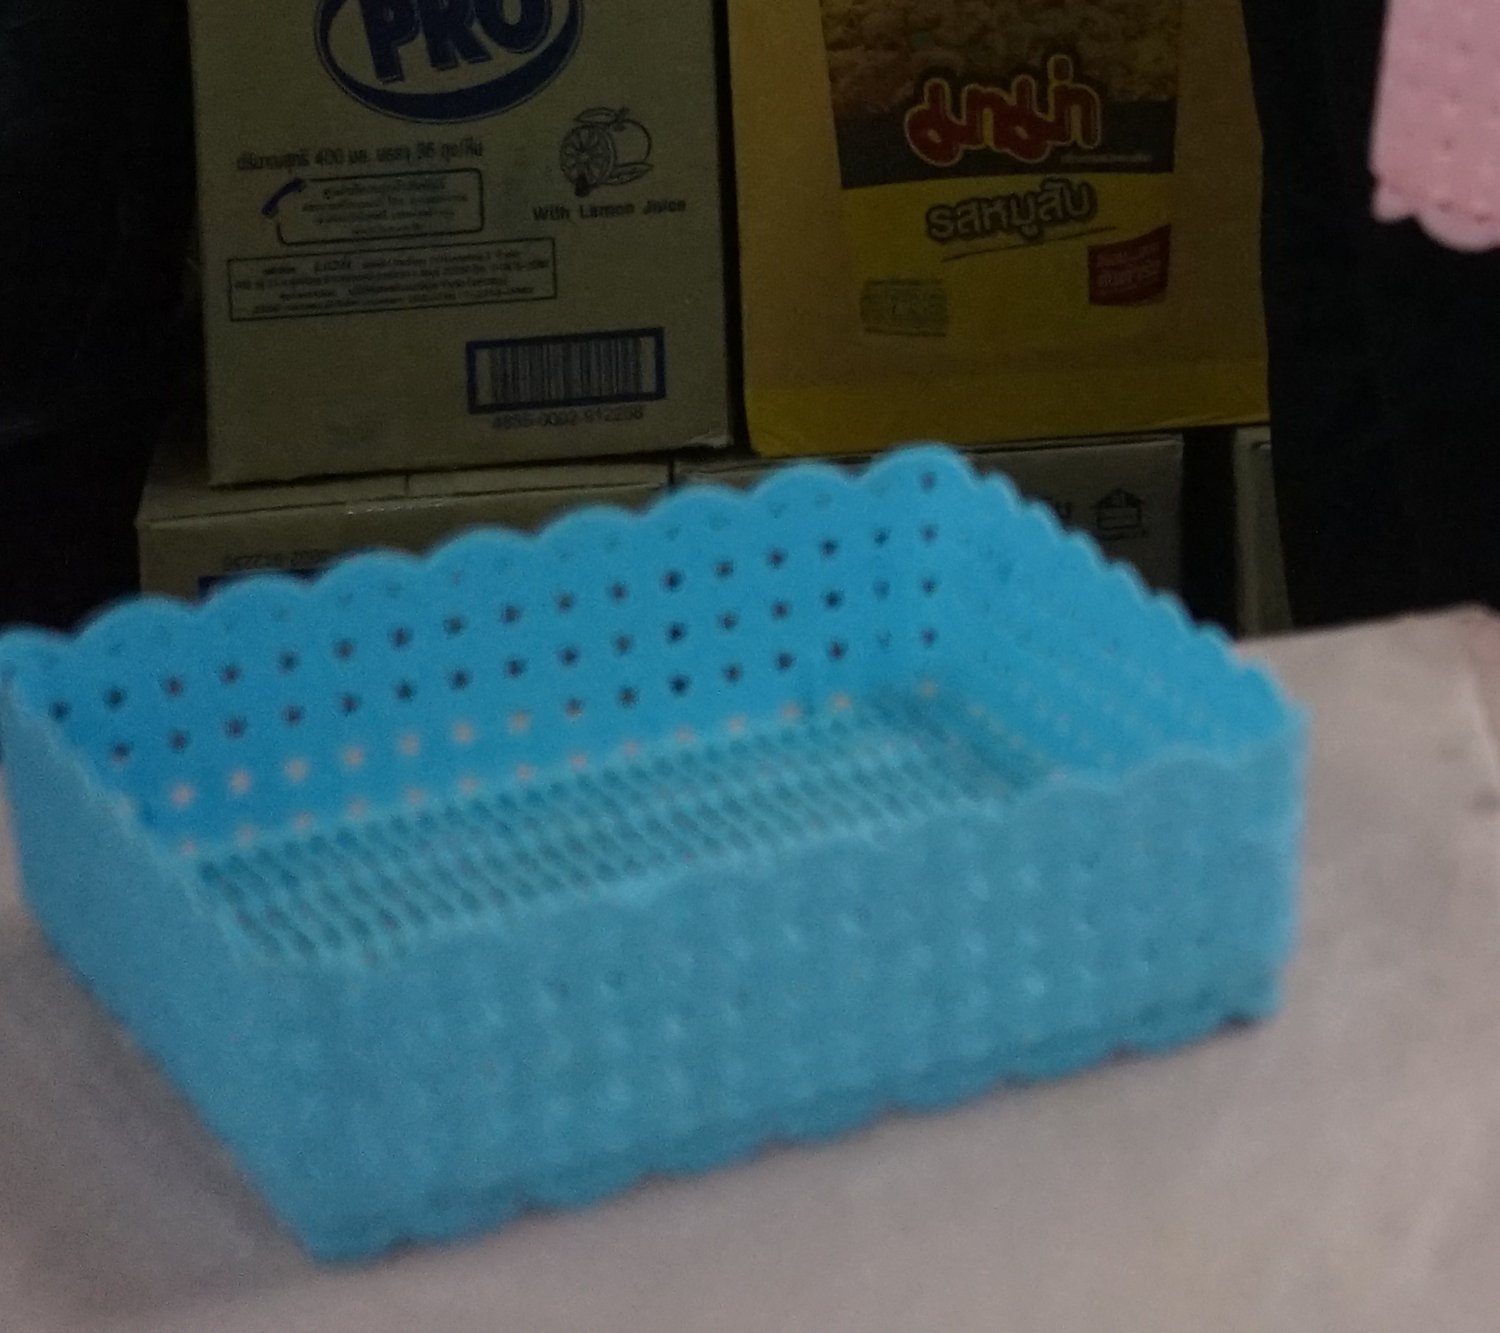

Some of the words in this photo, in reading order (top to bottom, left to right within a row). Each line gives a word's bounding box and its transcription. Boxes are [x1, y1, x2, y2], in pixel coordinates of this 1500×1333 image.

[904, 53, 1102, 167] มาม่า
[532, 202, 571, 221] With
[578, 202, 635, 219] Lemon
[926, 177, 1098, 244] รสหมูสับ
